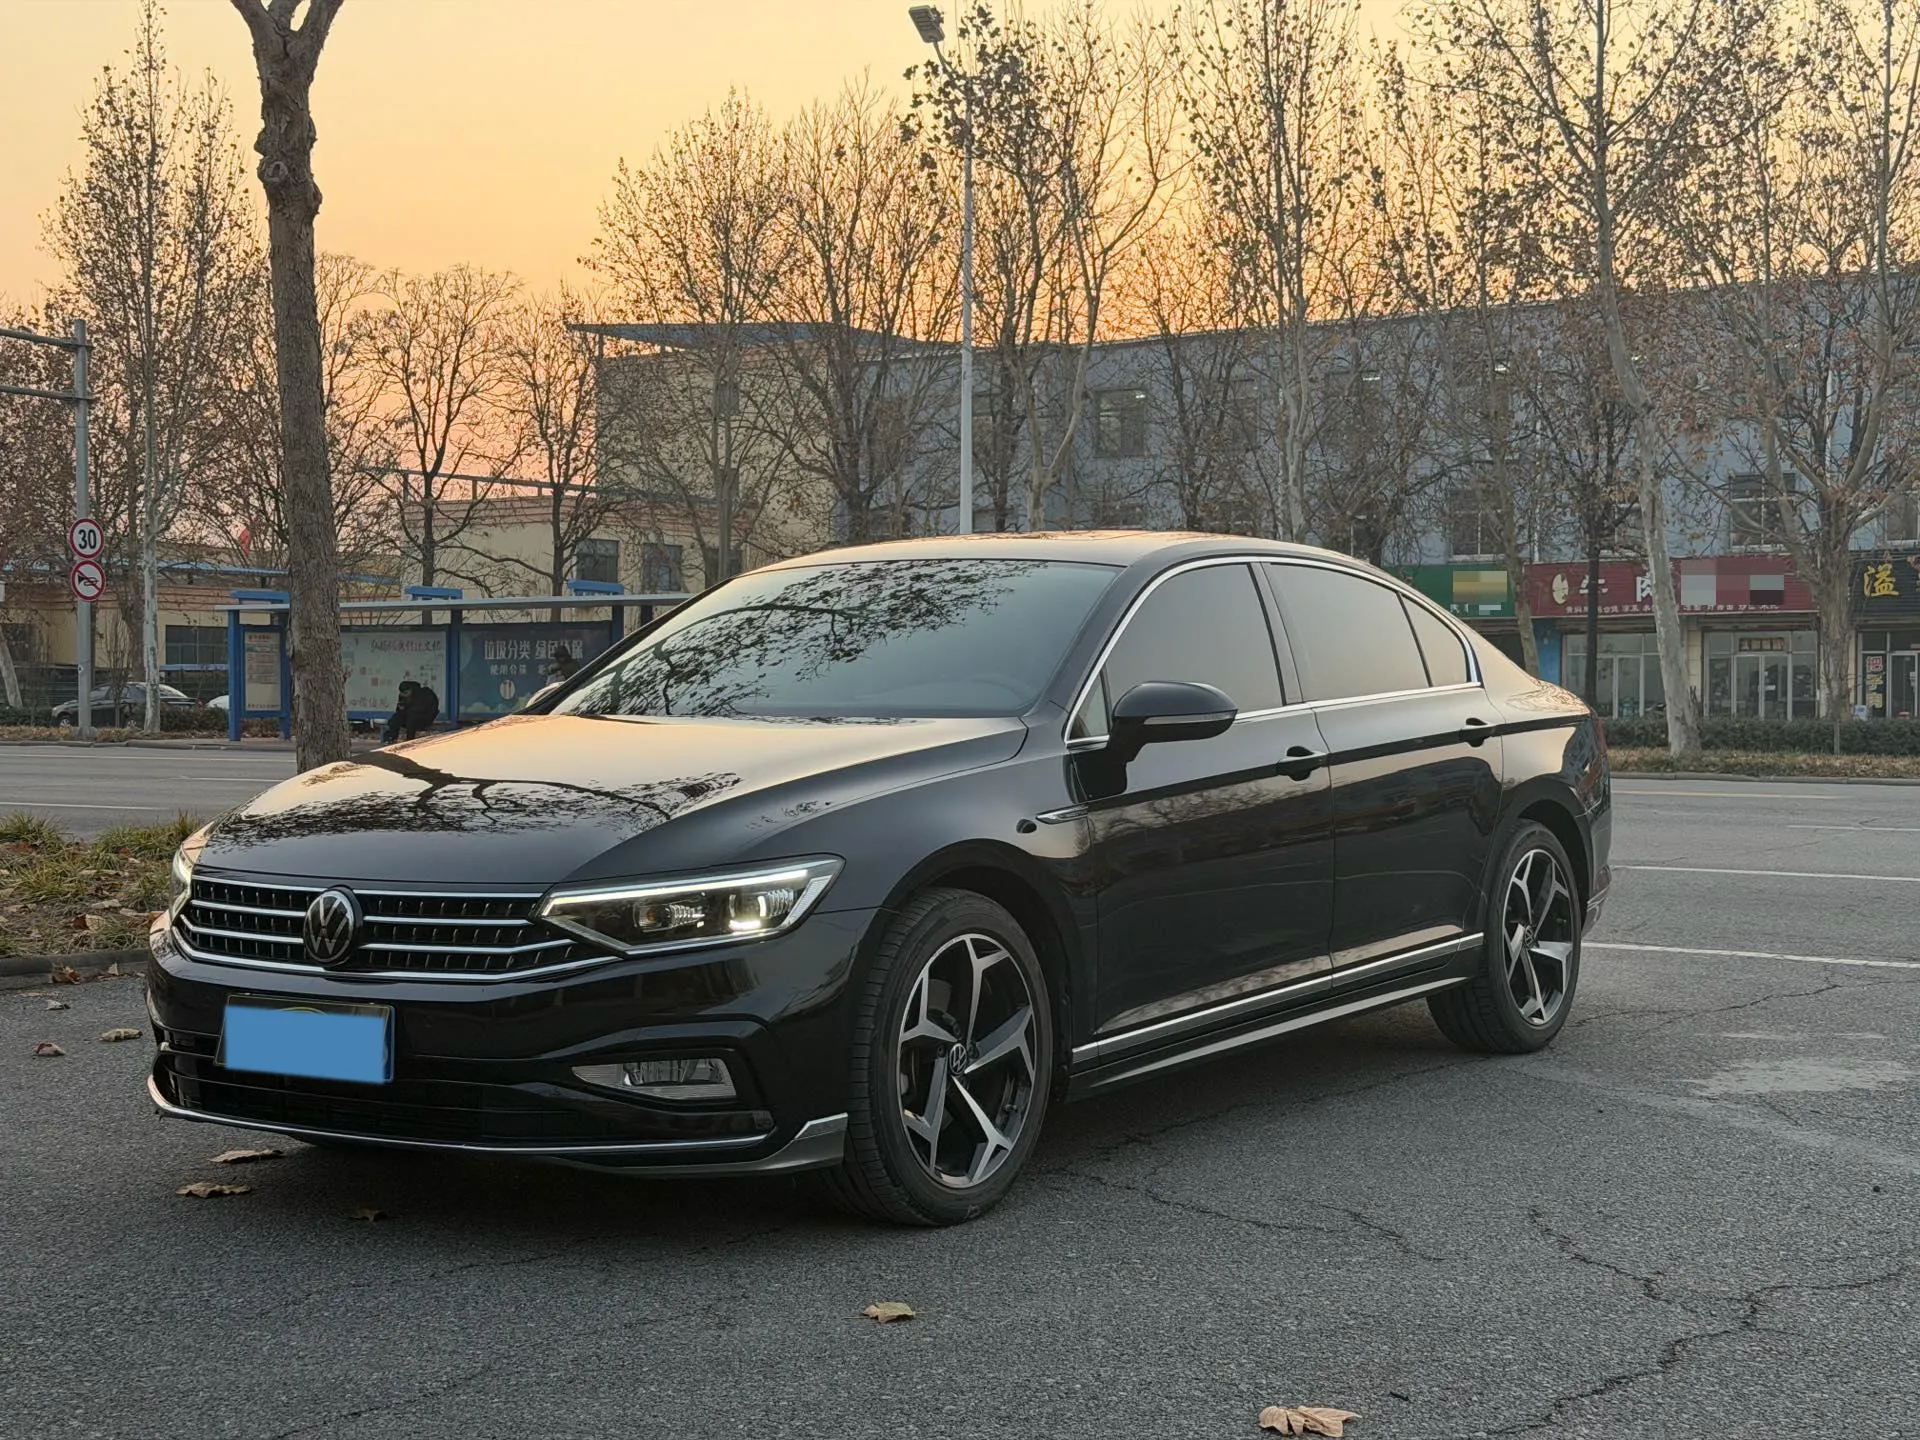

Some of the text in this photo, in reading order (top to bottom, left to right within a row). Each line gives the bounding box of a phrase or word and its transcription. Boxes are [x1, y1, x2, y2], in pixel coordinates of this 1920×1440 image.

[78, 529, 97, 549] 30
[1863, 563, 1900, 597] 溢
[484, 639, 531, 660] 垃圾分类
